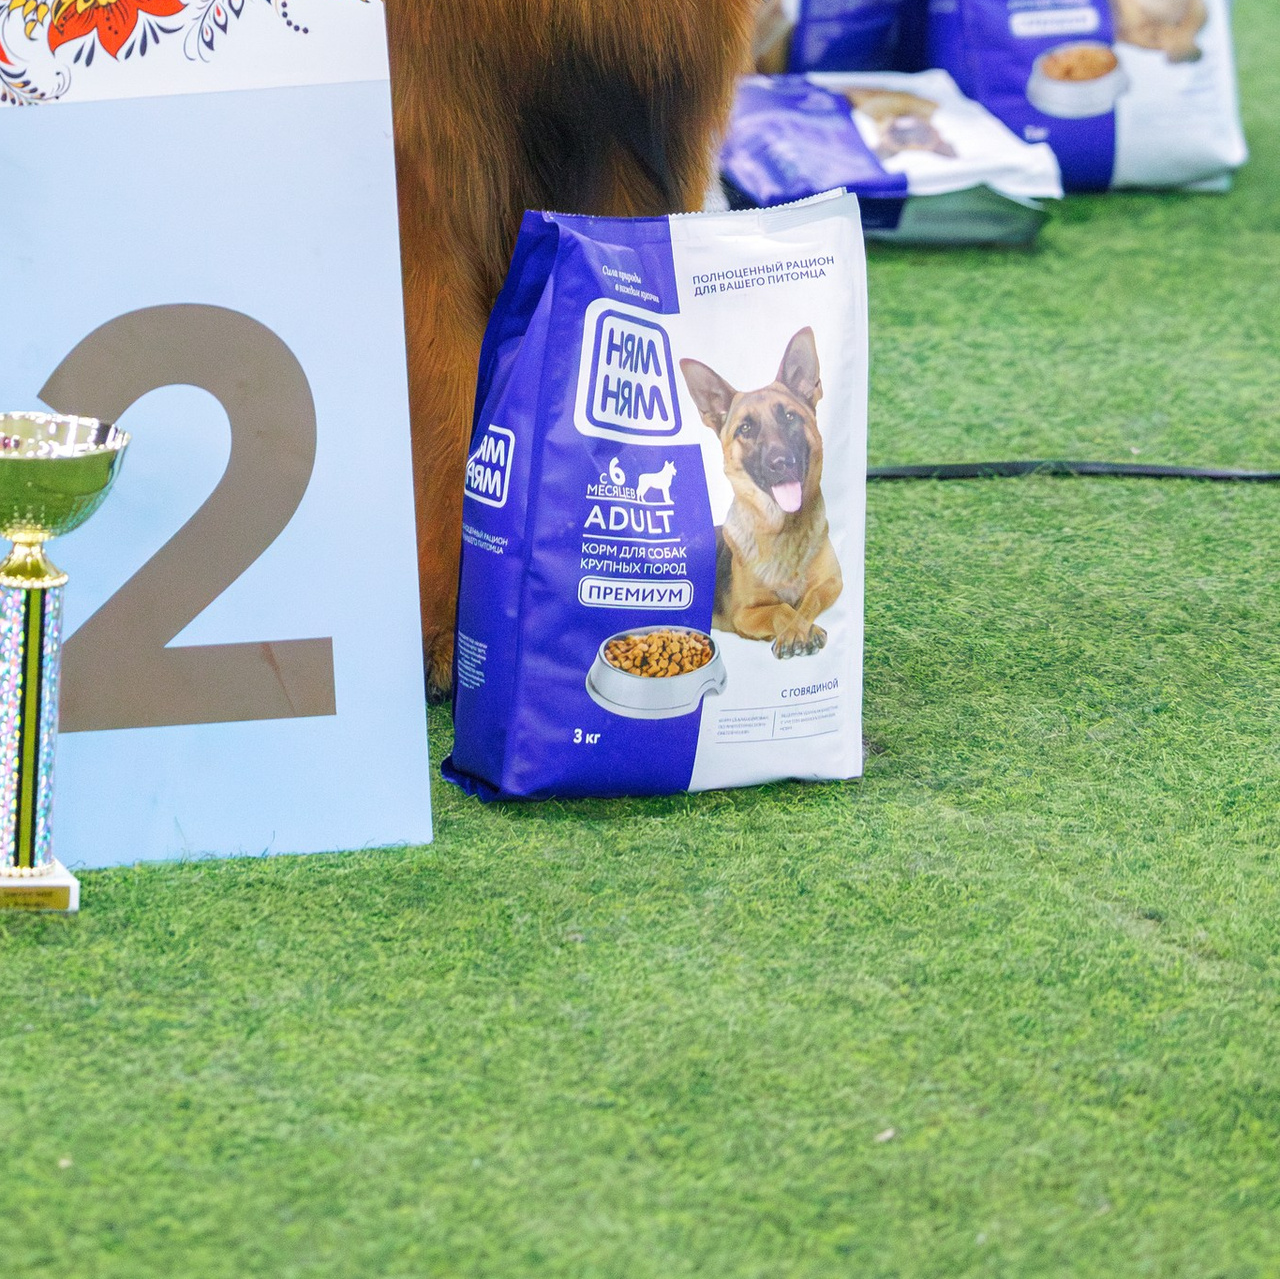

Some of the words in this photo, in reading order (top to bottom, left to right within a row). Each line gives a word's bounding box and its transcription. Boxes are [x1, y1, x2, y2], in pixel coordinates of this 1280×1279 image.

[692, 260, 785, 286] ПОЛНОЦЕННЫЙ
[786, 255, 836, 271] РАЦИОН
[694, 283, 718, 297] ДЛЯ
[719, 276, 766, 292] ВАШЕГО
[767, 268, 827, 285] ПИТОМЦА
[606, 327, 663, 377] НЯМ
[600, 374, 669, 421] НЯМ
[609, 456, 626, 486] 6
[586, 484, 636, 499] МЕСЯЦЕВ
[36, 303, 337, 734] 2
[583, 505, 674, 534] ADULT
[581, 542, 617, 556] КОРМ
[619, 546, 646, 558] ДЛЯ
[647, 546, 687, 559] СОБАК
[580, 558, 641, 573] КРУПНЫХ
[643, 562, 687, 575] ПОРОД
[588, 585, 683, 602] ПРЕМИУМ
[781, 689, 788, 699] С
[789, 677, 839, 698] ГОВЯДИНОЙ
[573, 727, 582, 744] 3
[585, 733, 601, 744] кг
